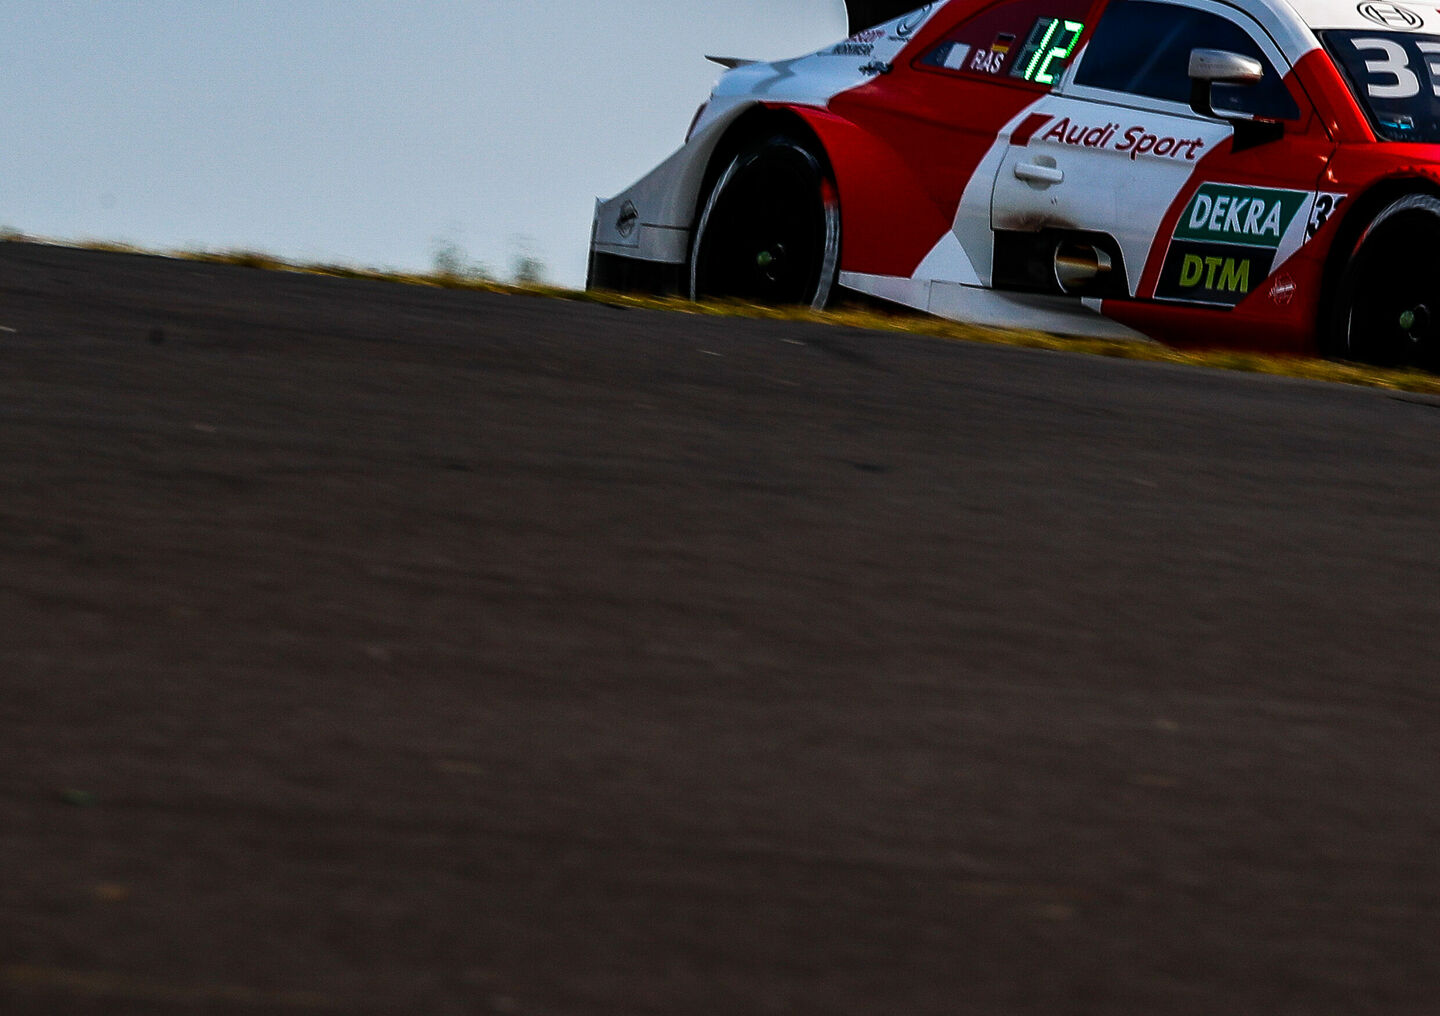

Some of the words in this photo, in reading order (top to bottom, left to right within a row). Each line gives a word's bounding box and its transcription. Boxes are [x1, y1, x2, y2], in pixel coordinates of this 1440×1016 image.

[1023, 18, 1085, 84] 12
[1041, 117, 1120, 149] Audi
[1114, 126, 1204, 160] Sport
[1188, 193, 1283, 237] DEKRA
[1178, 253, 1251, 294] DTM
